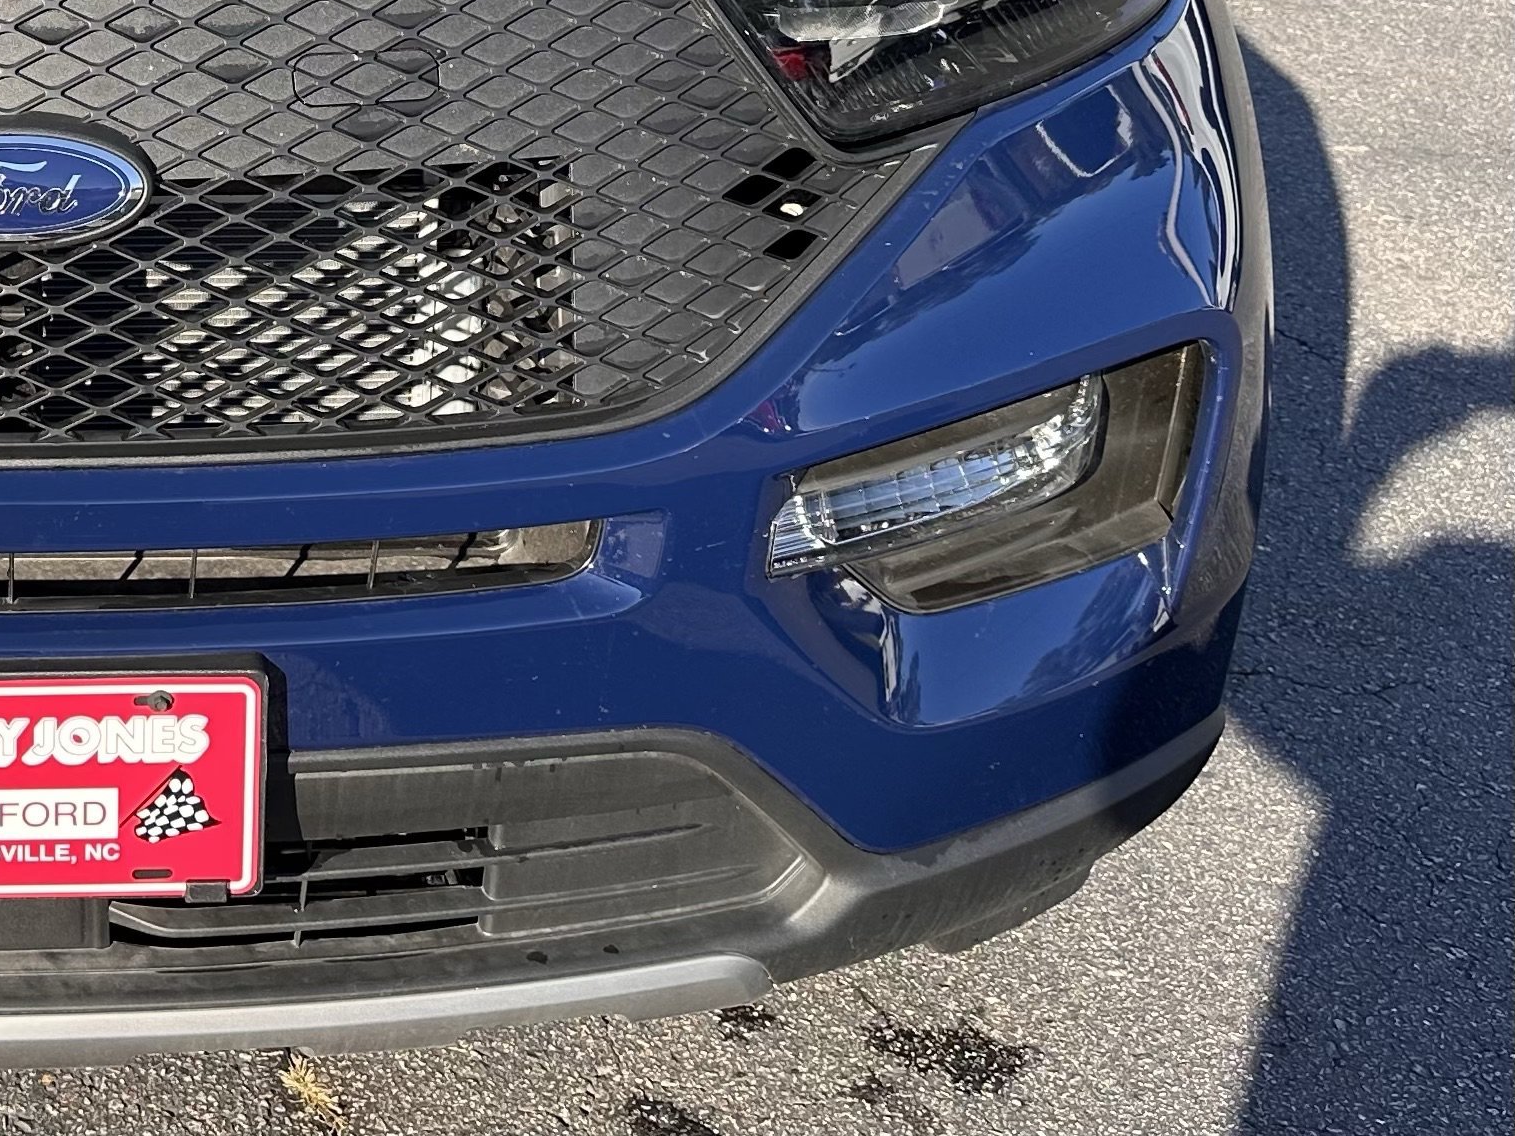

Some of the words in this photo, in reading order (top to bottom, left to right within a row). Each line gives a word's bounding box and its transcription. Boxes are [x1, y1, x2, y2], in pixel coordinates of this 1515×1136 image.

[21, 714, 211, 766] JONES
[0, 801, 107, 828] FORD
[85, 843, 121, 862] NC
